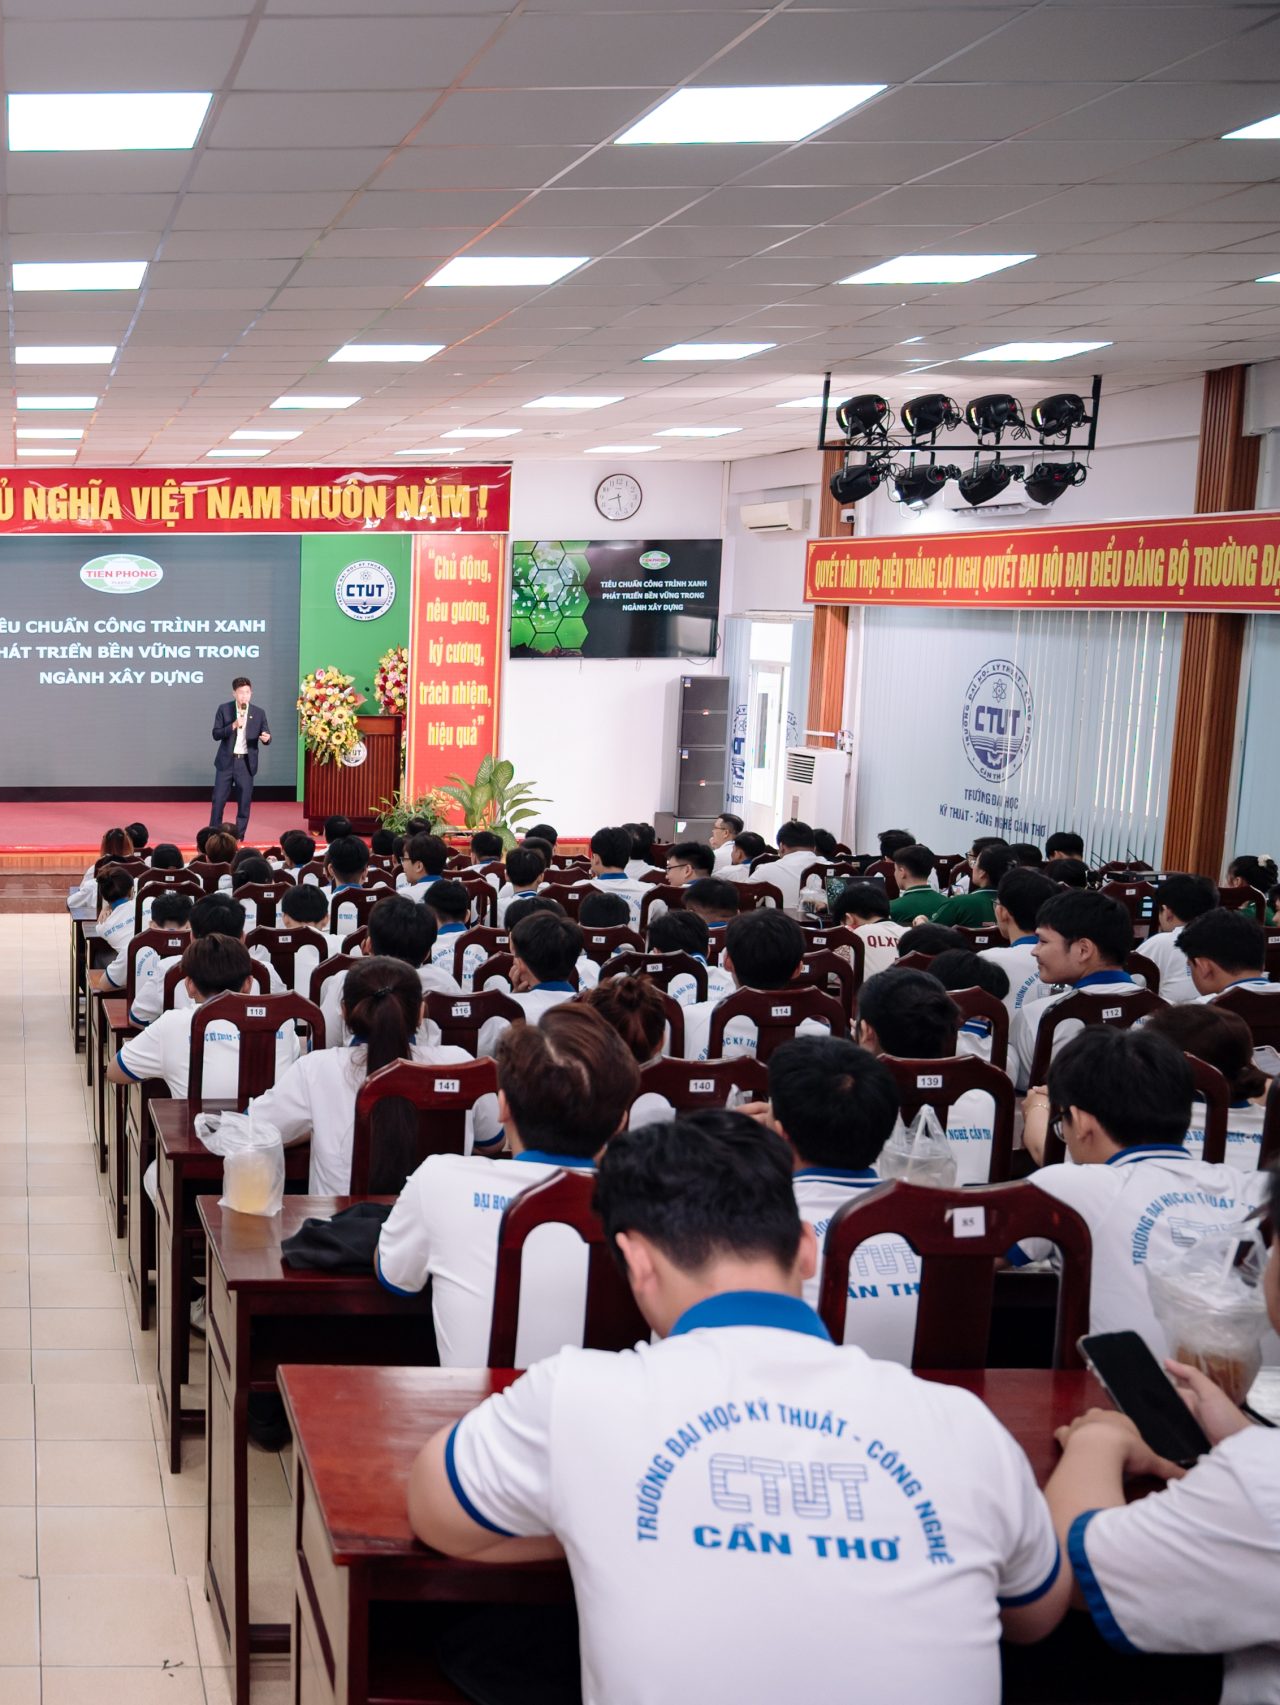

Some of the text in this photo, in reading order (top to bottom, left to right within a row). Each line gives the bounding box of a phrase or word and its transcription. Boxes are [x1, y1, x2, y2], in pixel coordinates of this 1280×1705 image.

[23, 478, 122, 521] NGHĨA
[131, 479, 198, 527] VIỆT
[207, 486, 281, 520] NAM
[291, 479, 386, 520] MUÔN
[395, 477, 470, 520] NĂM
[460, 555, 491, 586] động,
[815, 551, 840, 590] QUYẾT
[840, 554, 858, 588] TÂM
[859, 556, 880, 595] THỰC
[882, 552, 904, 595] HIỆN
[905, 545, 936, 588] THẮNG
[937, 554, 953, 595] LỢI
[955, 556, 981, 596] NGHỊ
[983, 543, 1018, 592] QUYẾT
[1019, 553, 1040, 596] ĐẠI
[1041, 545, 1063, 596] HỘI
[1065, 551, 1088, 596] ĐẠI
[1090, 535, 1122, 587] BIỂU
[1124, 536, 1165, 587] ĐẢNG
[1167, 539, 1190, 595] BỘ
[1193, 536, 1258, 587] TRƯỜNG
[346, 584, 385, 597] CTUT
[688, 580, 708, 588] XANH
[426, 597, 490, 624] nêu gương,
[26, 617, 89, 633] CHUẨN
[94, 617, 146, 633] CÔNG
[151, 617, 210, 633] TRÌNH
[214, 620, 266, 633] XANH
[36, 642, 92, 659] TRIỂN
[98, 642, 133, 659] BỀN
[138, 642, 191, 659] VỮNG
[195, 645, 260, 658] TRONG
[429, 636, 484, 666] kỷ cương,
[39, 668, 204, 687] NGÀNH XÂY DỰNG
[419, 681, 491, 710] trách nhiệm,
[975, 705, 1021, 737] CTUT
[428, 721, 453, 751] hiệu
[455, 1007, 469, 1015] 116
[1105, 1009, 1120, 1017] 112
[439, 1081, 456, 1090] 141
[694, 1081, 711, 1090] 140
[921, 1077, 939, 1086] 139
[637, 1397, 955, 1566] TRƯỜNG ĐẠI HỌC KỸ THUẬT CÔNG NGHỆ
[709, 1452, 869, 1521] CTUT
[807, 1534, 901, 1562] THƠ
